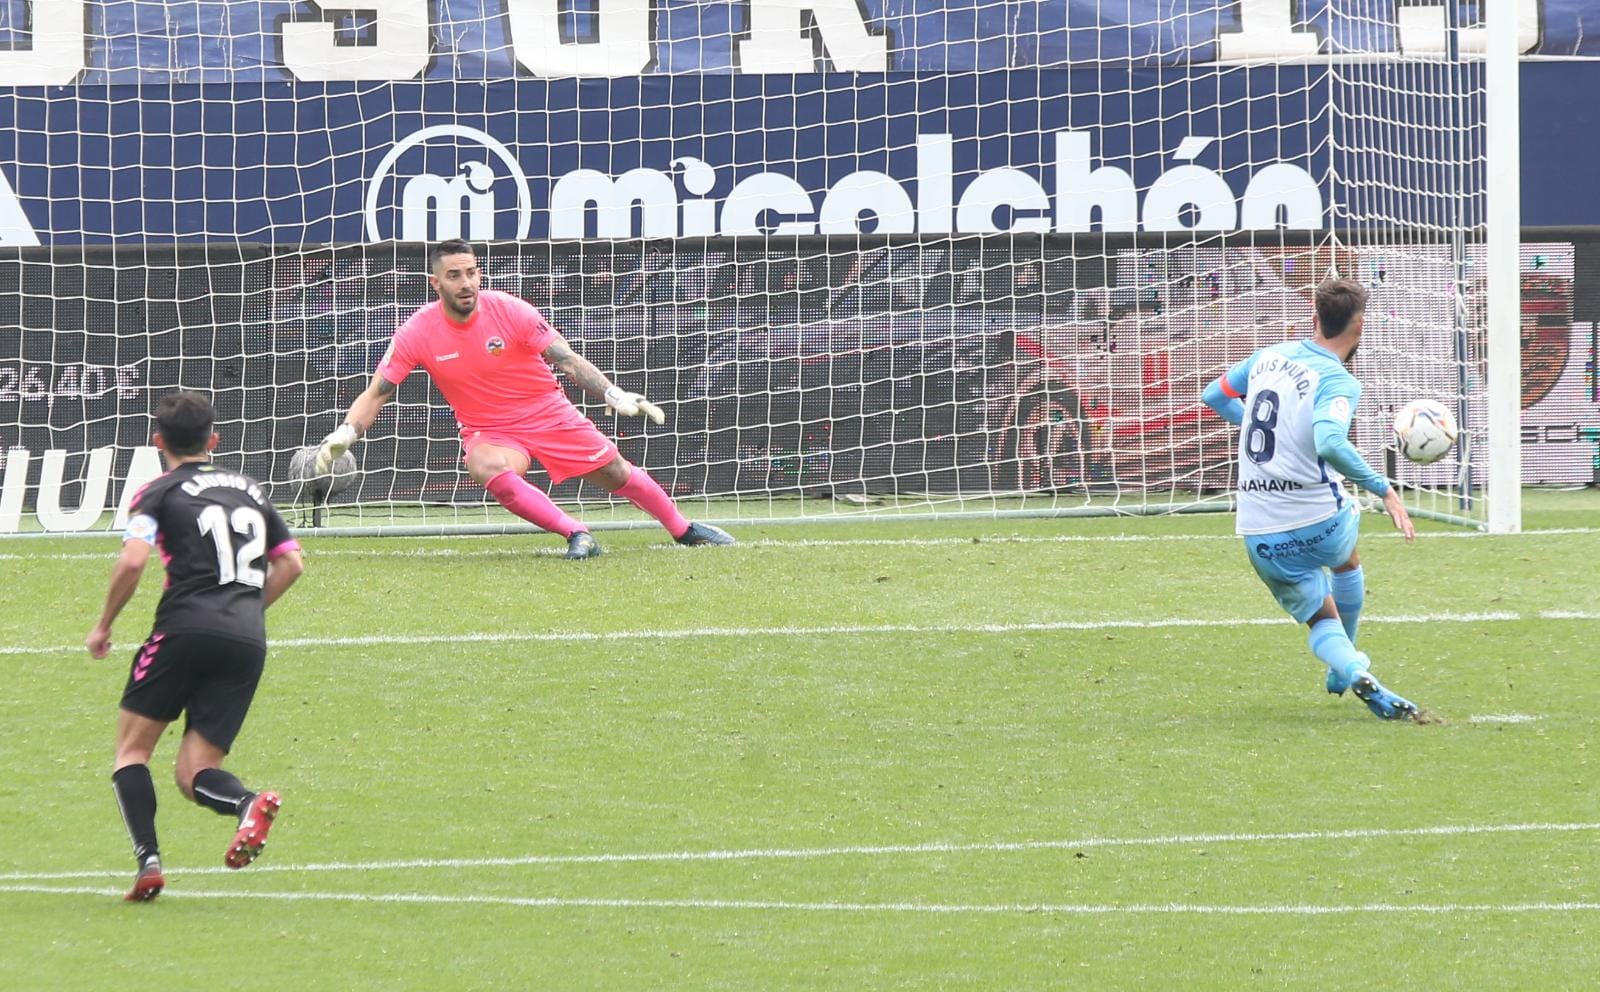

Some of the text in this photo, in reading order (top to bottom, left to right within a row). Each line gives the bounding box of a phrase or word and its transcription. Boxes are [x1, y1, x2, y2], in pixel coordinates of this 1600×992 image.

[549, 131, 1323, 240] micolchón
[1245, 389, 1280, 465] 8
[196, 505, 267, 589] 12
[1306, 535, 1325, 547] DEL
